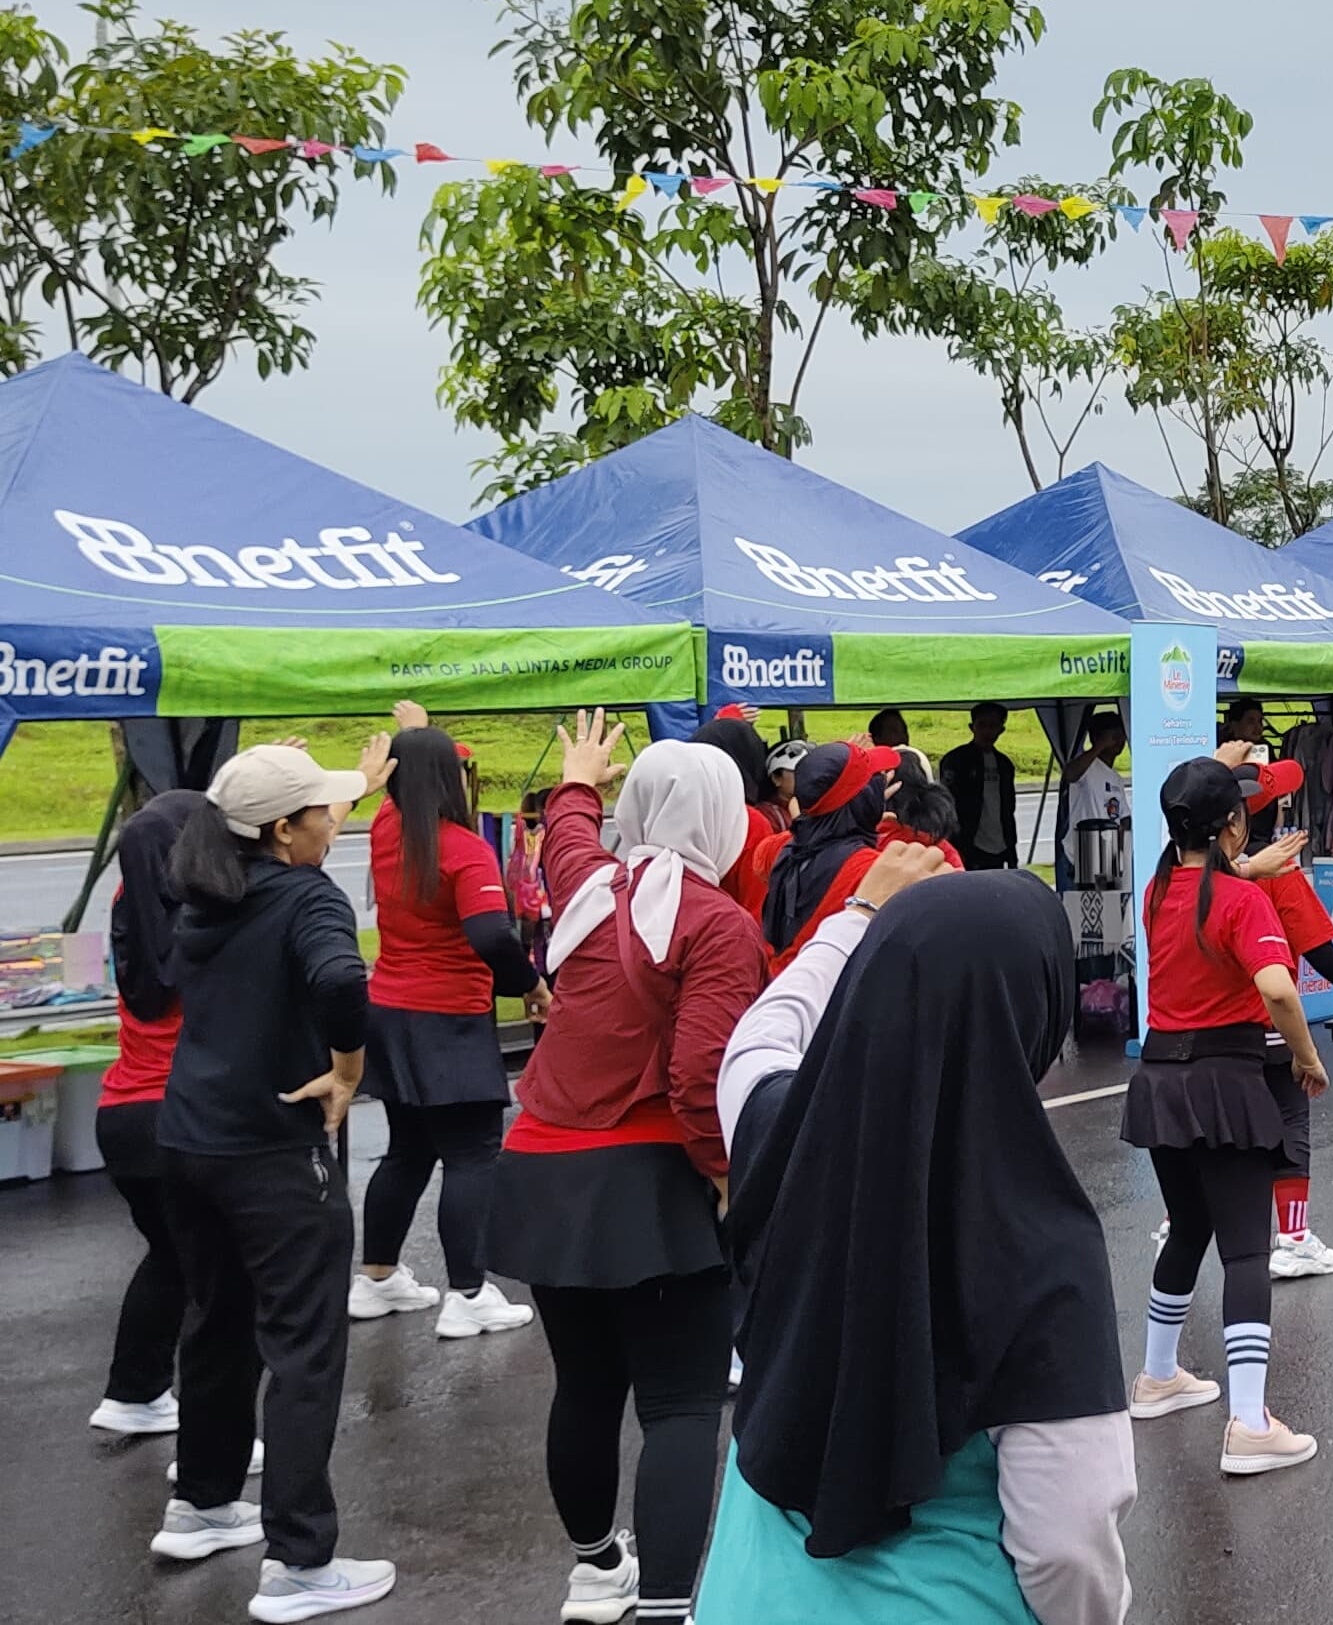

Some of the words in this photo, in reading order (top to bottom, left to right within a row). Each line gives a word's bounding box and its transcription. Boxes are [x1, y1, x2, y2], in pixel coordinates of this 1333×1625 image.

[391, 663, 433, 678] PART
[440, 663, 461, 675] OF
[471, 661, 512, 675] JALA
[516, 659, 569, 674] LINTAS
[573, 657, 617, 672] MEDIA
[622, 656, 673, 670] GROUP
[1060, 650, 1129, 674] bnetfit.
